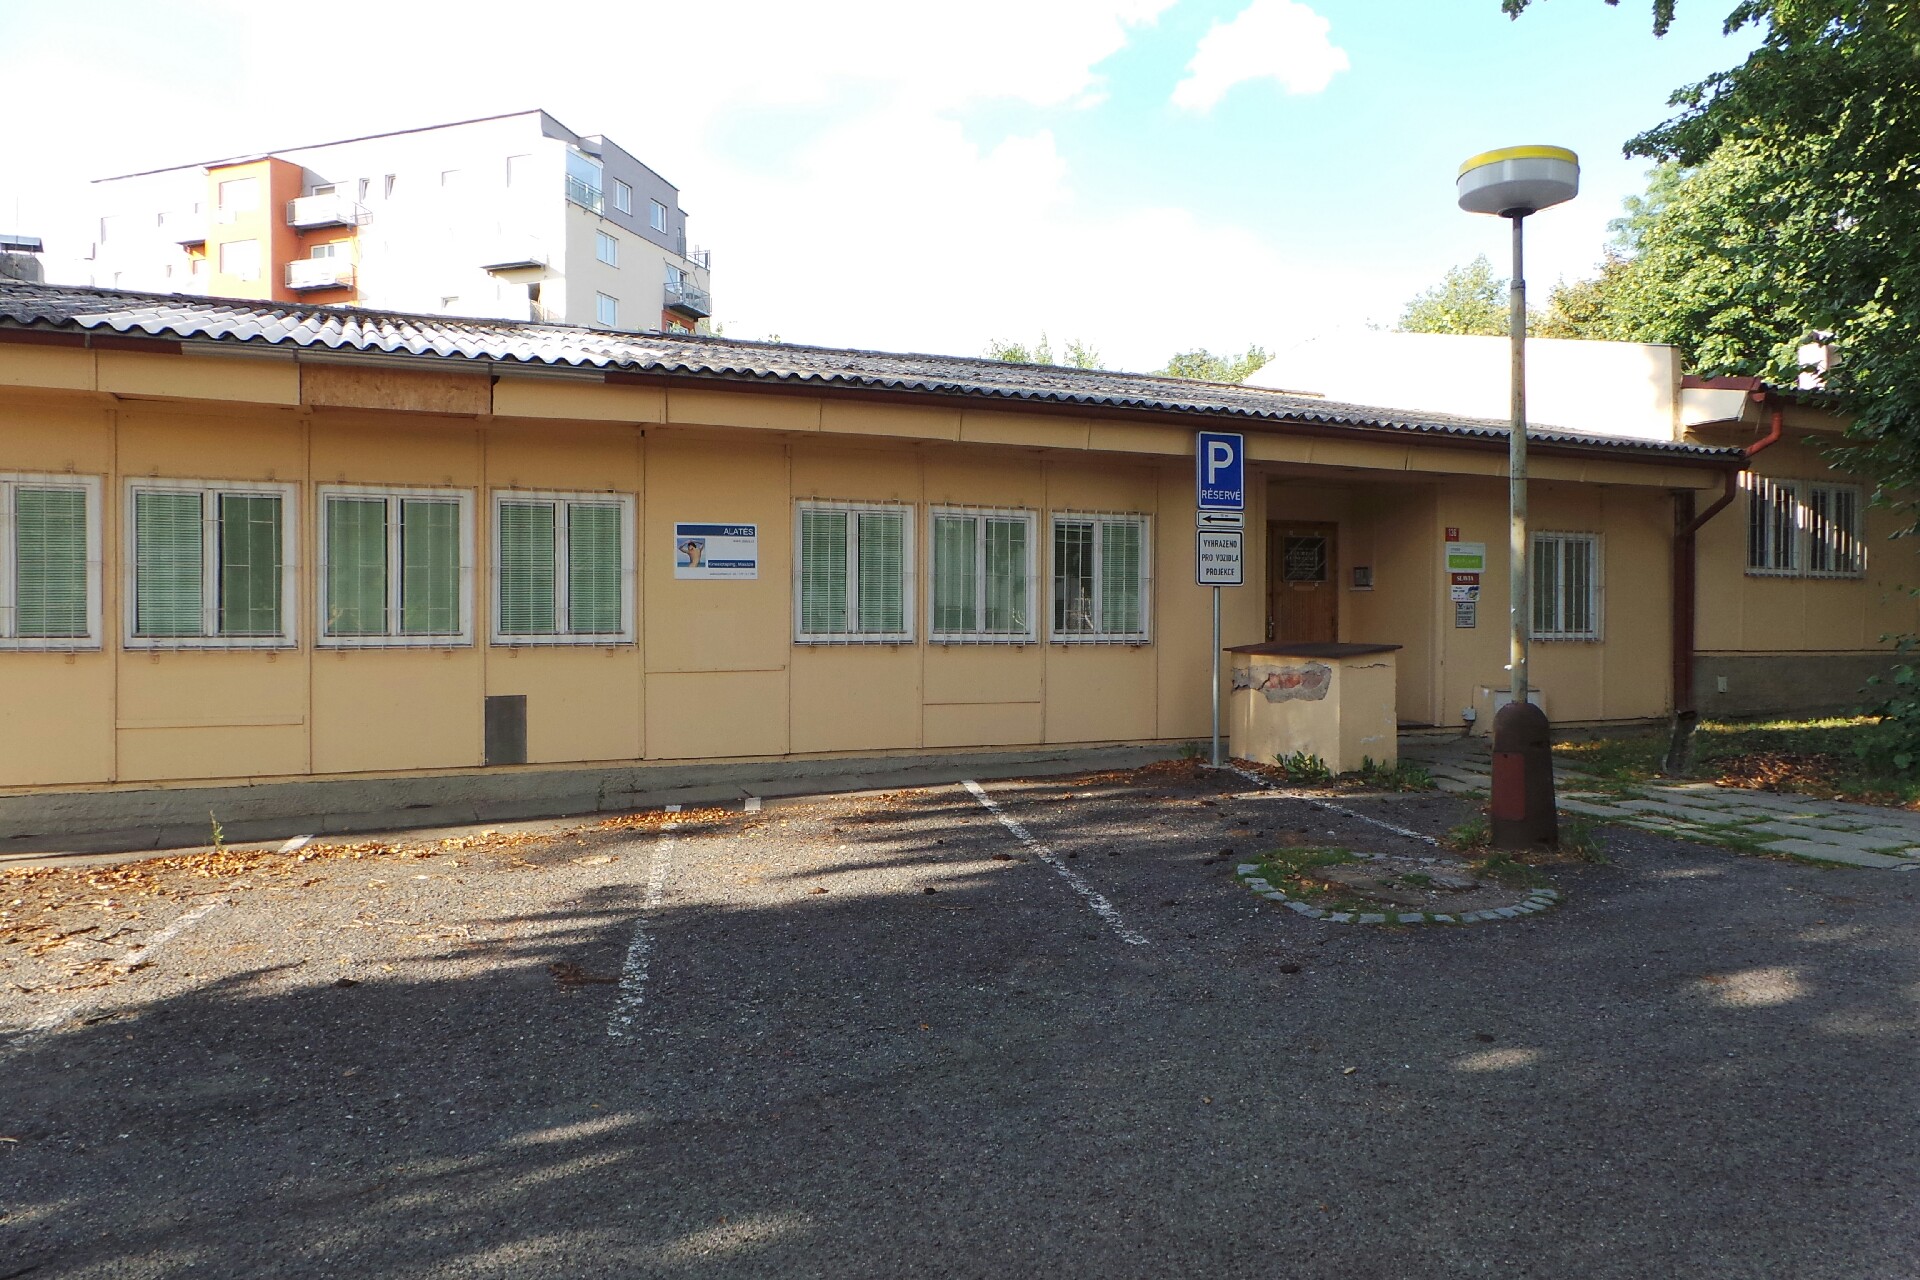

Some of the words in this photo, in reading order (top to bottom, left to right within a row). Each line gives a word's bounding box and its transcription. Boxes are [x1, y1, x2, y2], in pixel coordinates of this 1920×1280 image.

[1208, 441, 1234, 484] P
[1201, 488, 1241, 501] RÉSERVÉ
[723, 527, 754, 536] ALATÉS
[1203, 539, 1238, 548] VYHRAZENO
[1201, 553, 1214, 562] PRO
[1215, 553, 1240, 563] VOZIDLA
[1205, 567, 1235, 576] PROJEKCE
